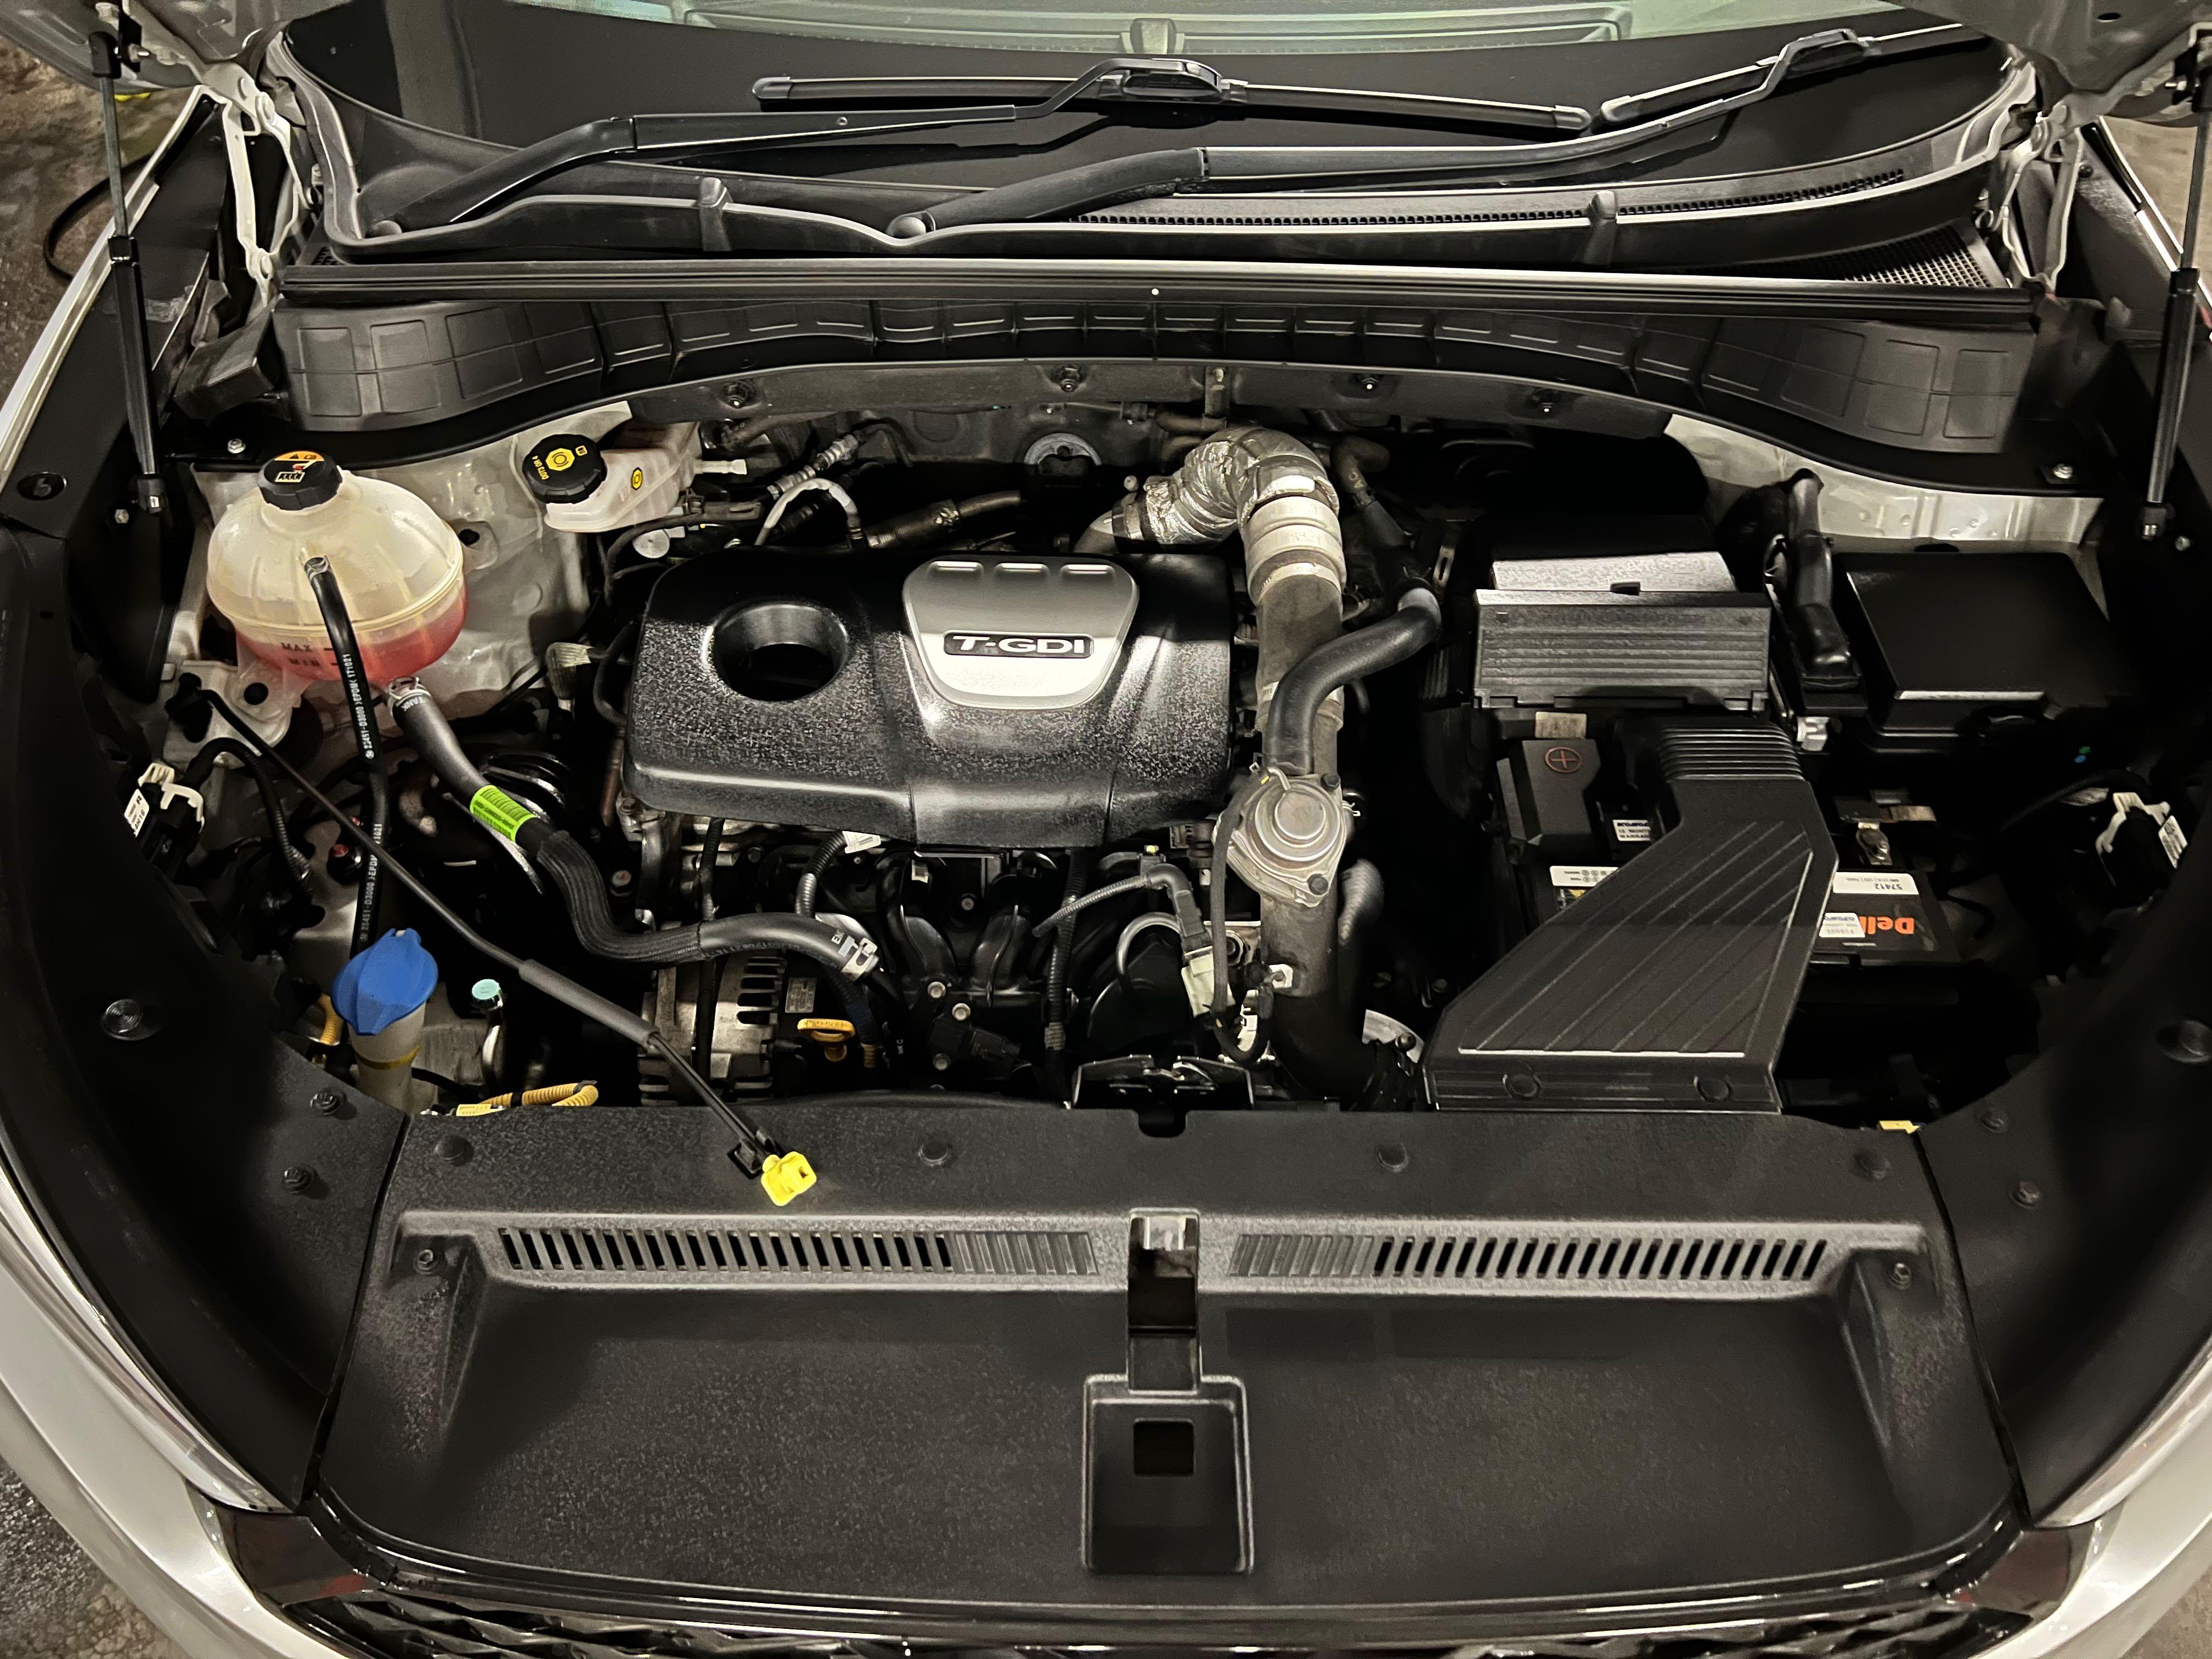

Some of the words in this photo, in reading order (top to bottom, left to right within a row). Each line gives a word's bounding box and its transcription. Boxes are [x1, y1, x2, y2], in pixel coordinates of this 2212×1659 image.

[281, 642, 312, 652] MAX
[952, 635, 1085, 654] T-GDI
[289, 658, 320, 667] MIN
[401, 696, 426, 712] TANK
